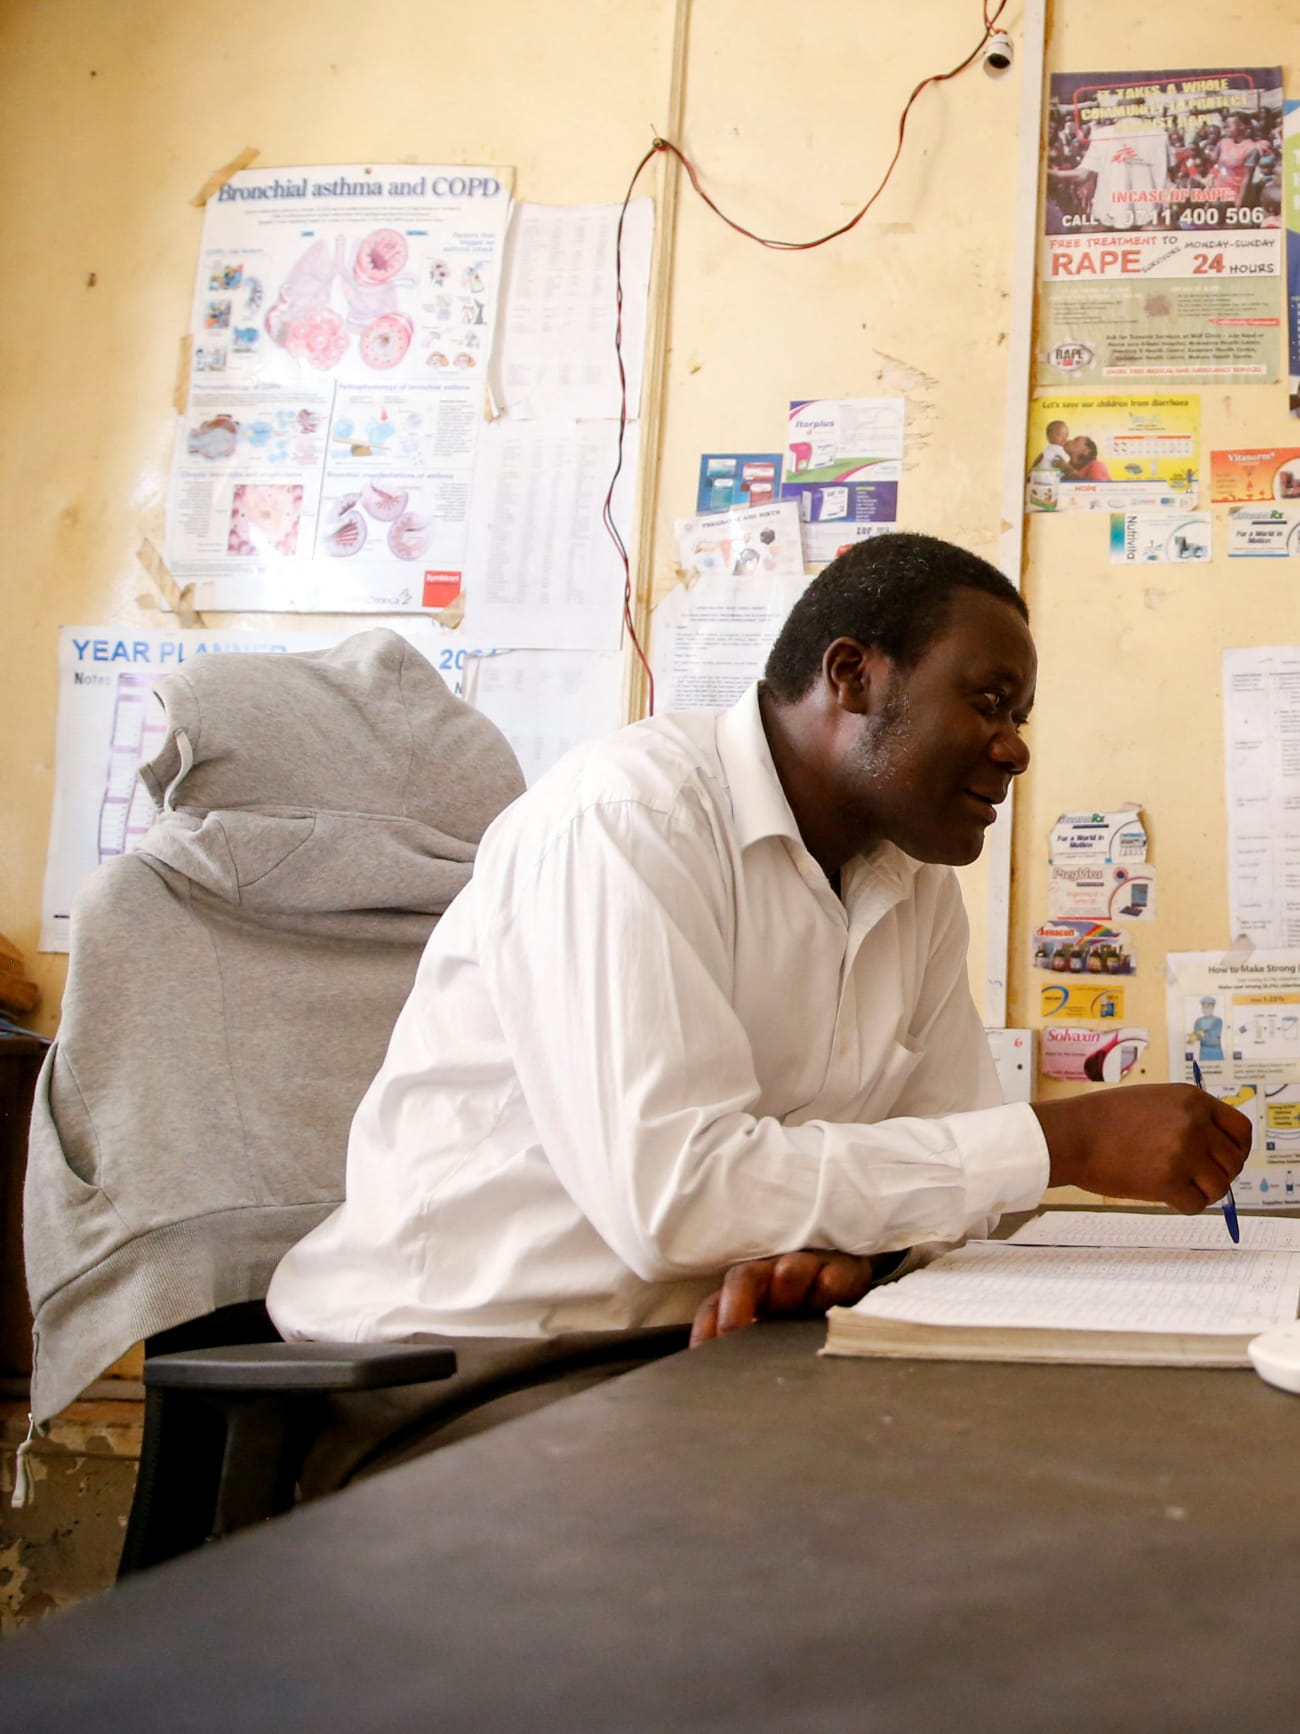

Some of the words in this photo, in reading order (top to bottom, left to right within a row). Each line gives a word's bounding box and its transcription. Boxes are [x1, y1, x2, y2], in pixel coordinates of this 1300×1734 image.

[1116, 85, 1161, 98] TAKES
[1166, 83, 1177, 95] A
[1182, 79, 1229, 92] WHOLE
[1080, 104, 1164, 121] COMMUNITY
[217, 179, 307, 202] Bronchial
[312, 178, 382, 197] asthma
[388, 177, 424, 196] and
[432, 177, 500, 197] COPD
[1112, 189, 1165, 204] INCASE
[1062, 213, 1099, 227] CALL
[1180, 207, 1219, 225] 400
[1225, 207, 1265, 224] 506
[1049, 238, 1081, 249] FREE
[1087, 236, 1158, 247] TREATMENT
[1163, 236, 1178, 245] TO
[1184, 239, 1275, 249] MONDAY-SUNDAY
[1051, 249, 1142, 277] RAPE
[1192, 252, 1225, 275] 24
[1229, 263, 1275, 274] HOURS
[1097, 400, 1128, 408] children
[1126, 516, 1137, 560] Nutrivita
[73, 640, 150, 662] YEAR
[1208, 966, 1228, 974] How
[1230, 966, 1239, 974] to
[1241, 964, 1264, 973] Make
[1266, 964, 1296, 974] Strong
[1048, 1028, 1100, 1041] Solvaxin
